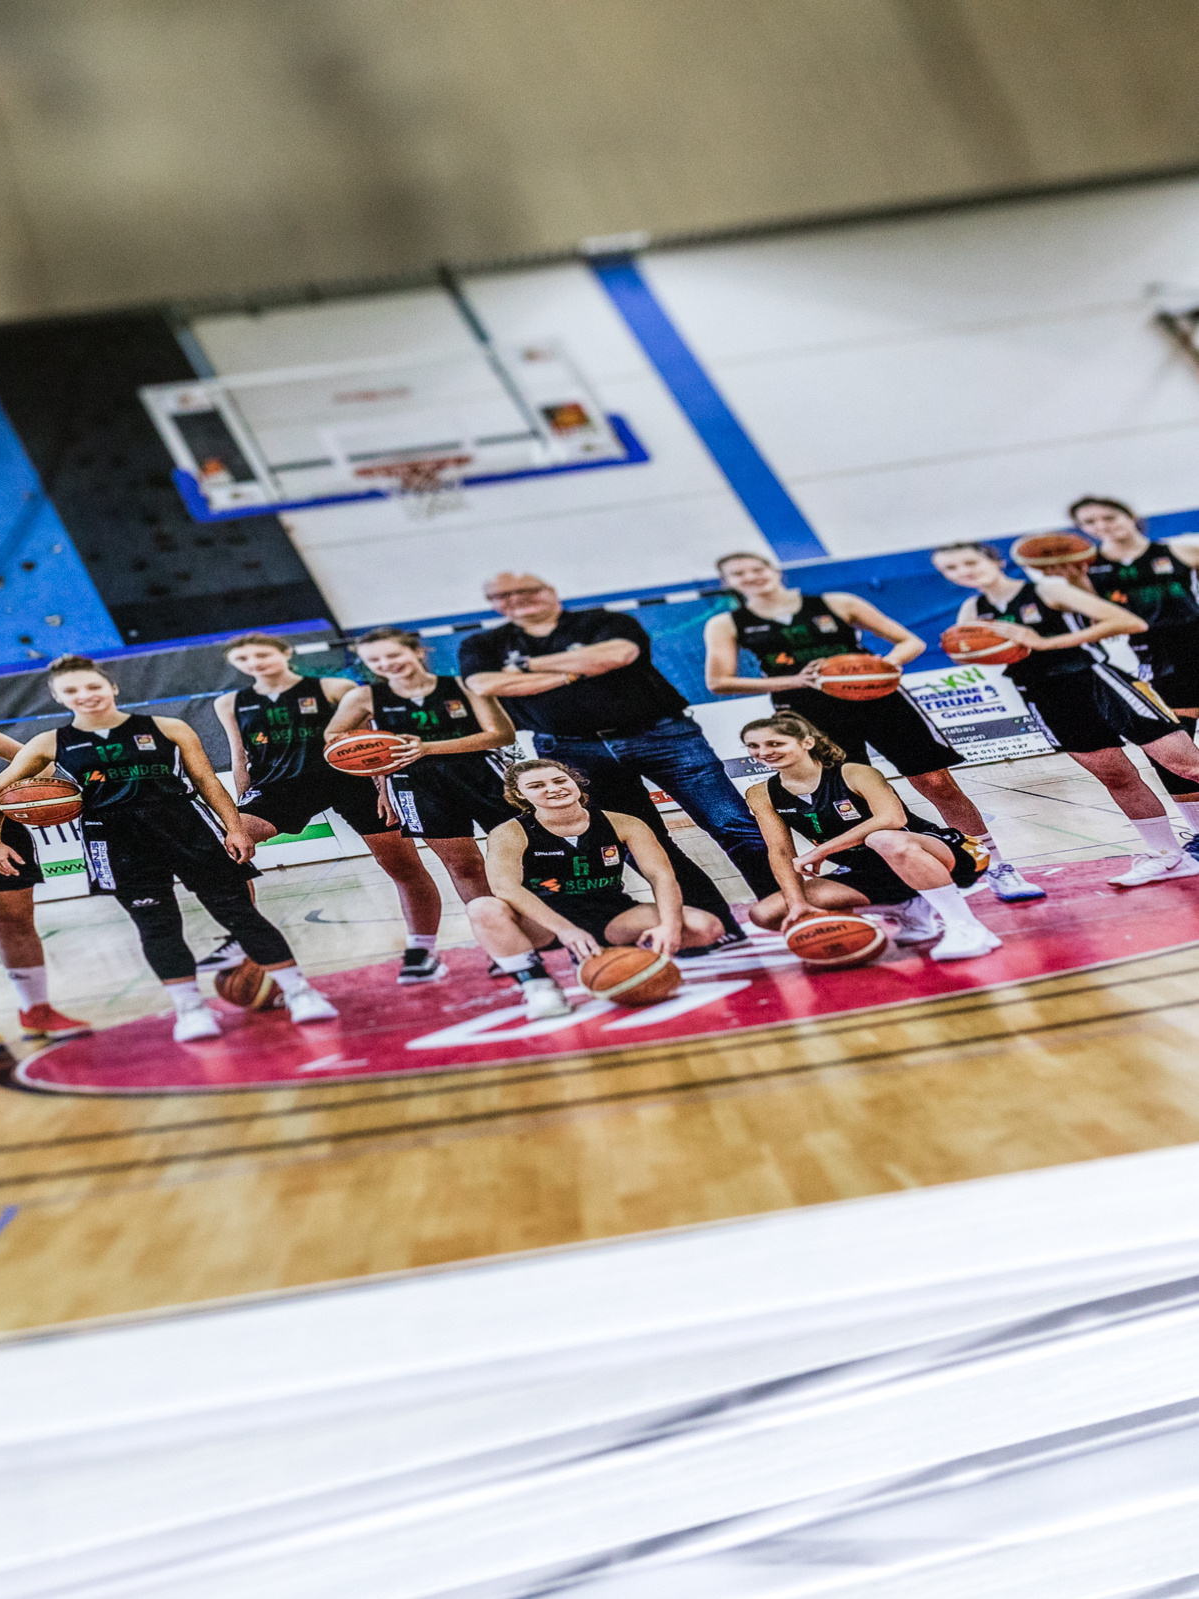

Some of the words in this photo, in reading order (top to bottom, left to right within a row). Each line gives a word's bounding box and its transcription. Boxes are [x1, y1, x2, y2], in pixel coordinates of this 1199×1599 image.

[941, 705, 1006, 719] Grünberg
[336, 740, 384, 757] molten
[107, 764, 170, 779] BENDER
